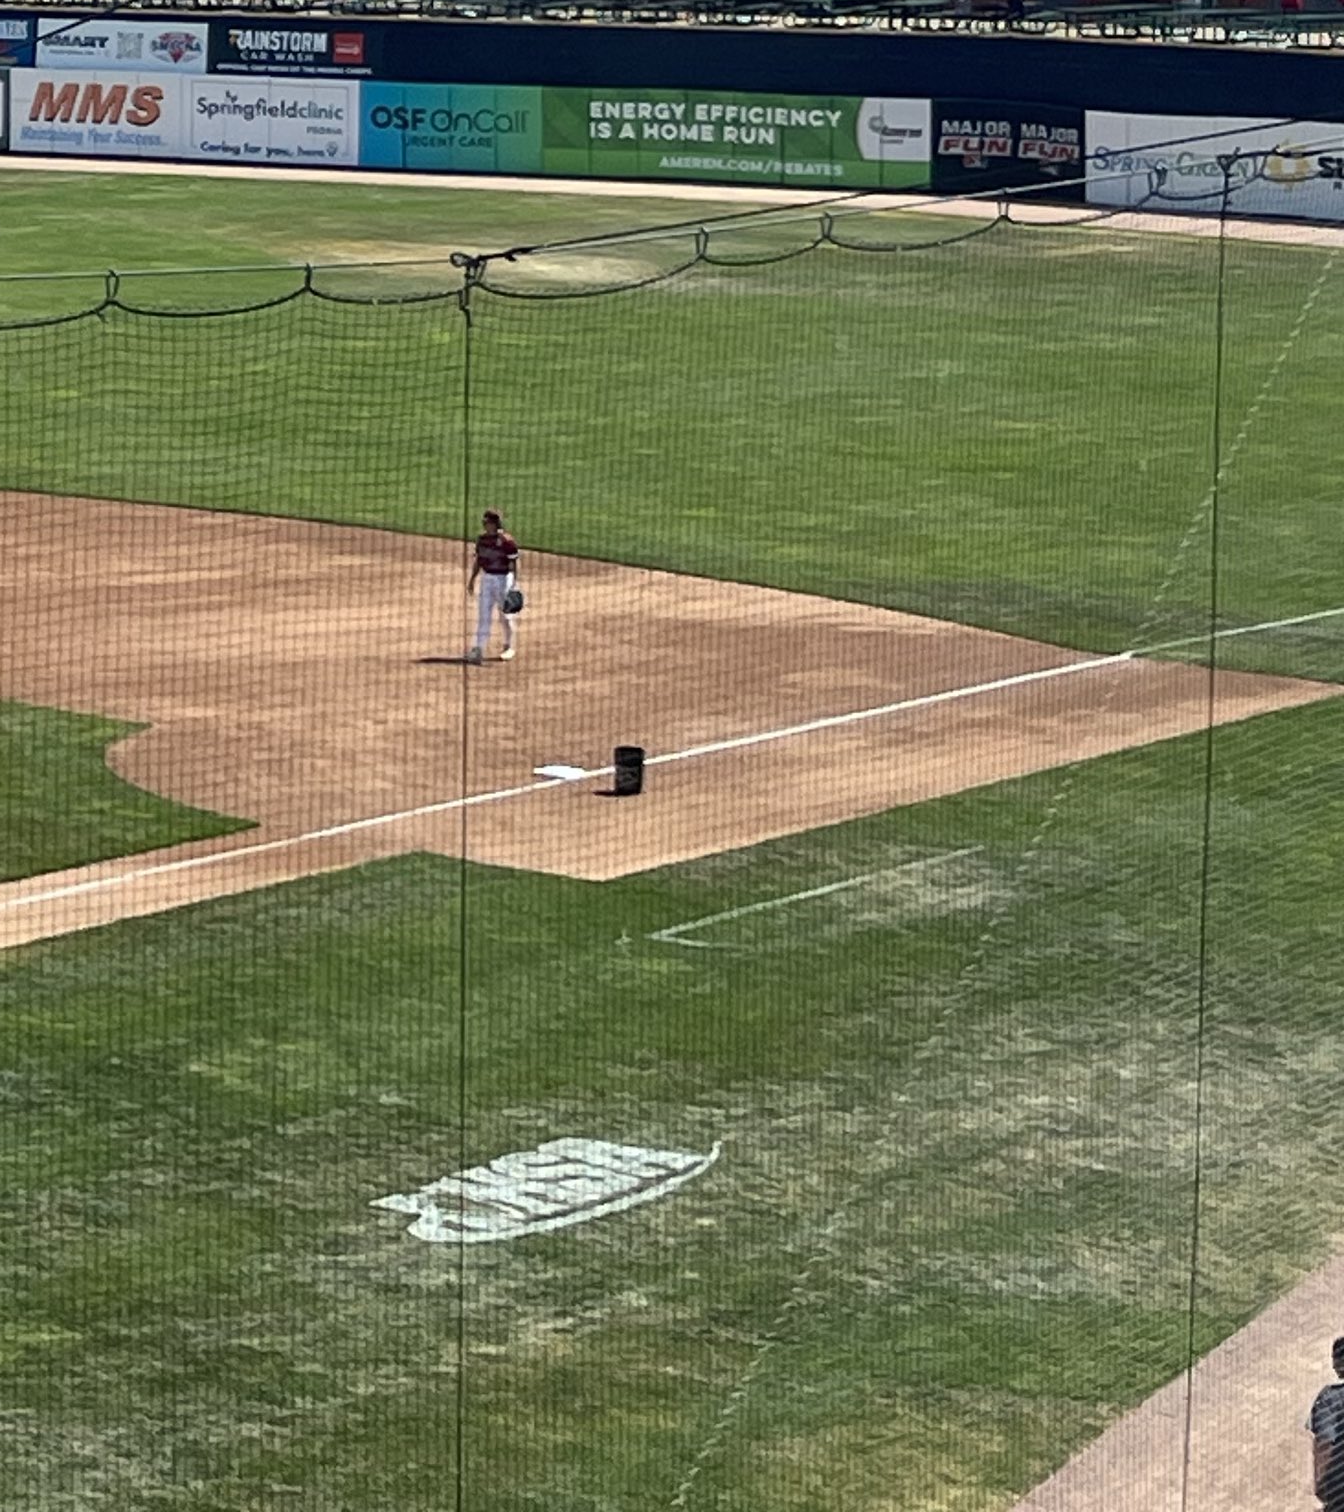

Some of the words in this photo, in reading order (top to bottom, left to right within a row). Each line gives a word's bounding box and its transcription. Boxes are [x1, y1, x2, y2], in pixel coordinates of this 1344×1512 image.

[29, 81, 164, 127] MMS
[370, 105, 426, 131] OSF
[430, 108, 530, 133] OnCall
[589, 101, 686, 120] ENERGY
[694, 104, 842, 128] EFFICIENCY
[589, 123, 612, 138] IS
[618, 122, 636, 138] A
[644, 123, 714, 142] HOME
[723, 126, 775, 144] RUN
[941, 120, 1011, 137] MAJOR
[1020, 123, 1079, 143] MAJOR
[458, 137, 493, 147] CARE
[943, 139, 1009, 153] FUN
[1021, 142, 1076, 159] FUN
[659, 156, 844, 176] AMEREN.COM/REBATES
